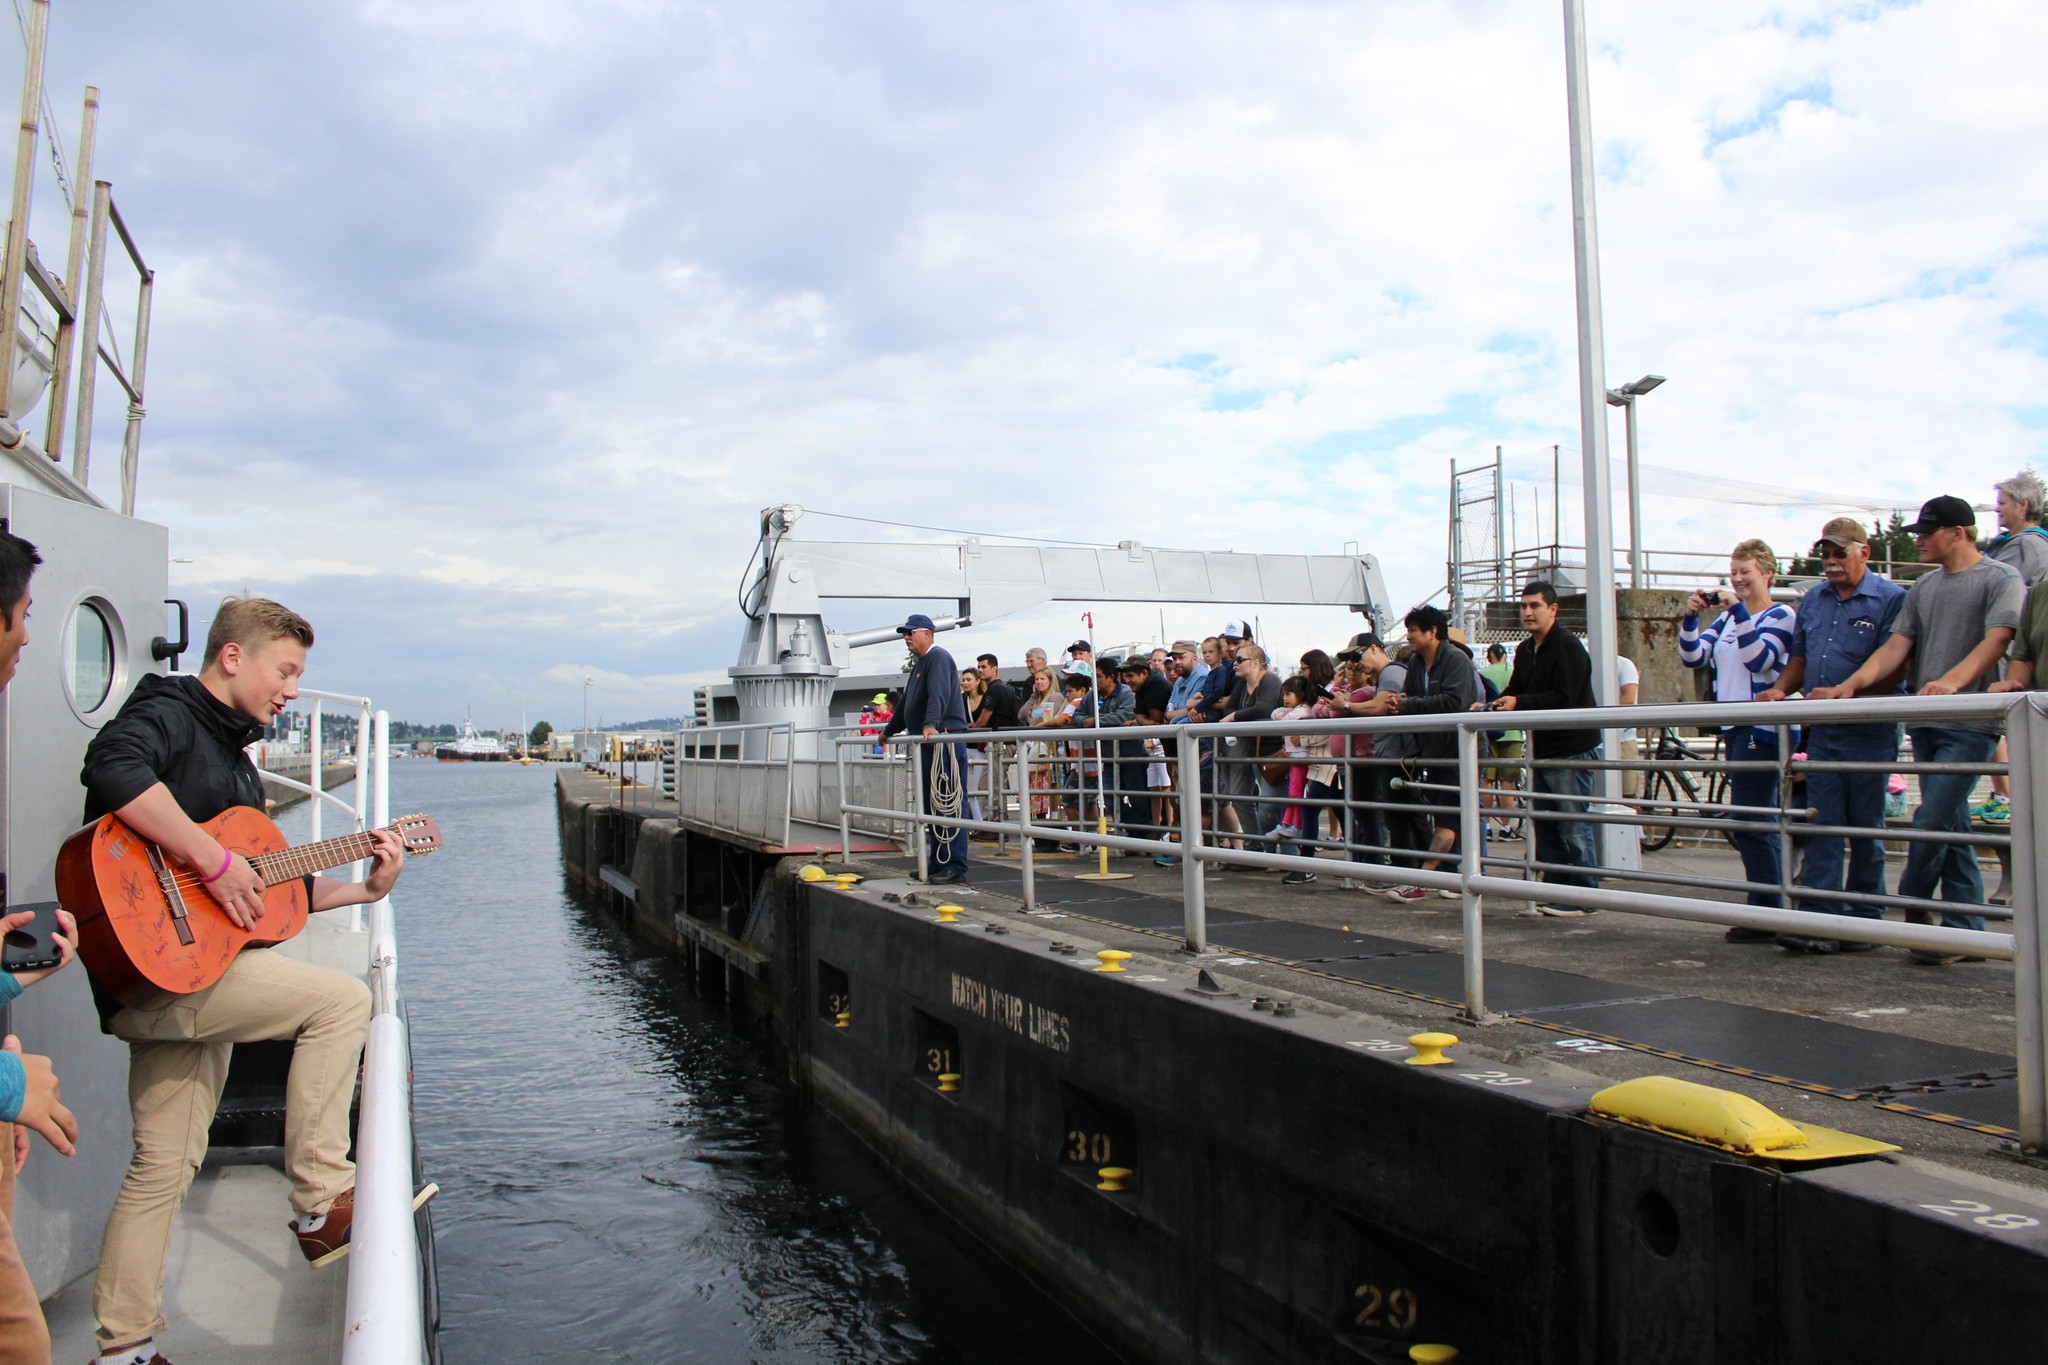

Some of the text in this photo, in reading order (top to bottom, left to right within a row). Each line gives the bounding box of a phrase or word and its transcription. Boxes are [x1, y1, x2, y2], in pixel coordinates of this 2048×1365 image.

[951, 971, 1070, 1053] WATCH YOUR LINES
[1345, 1038, 1409, 1052] 29
[926, 1048, 951, 1073] 31
[1458, 1070, 1533, 1086] 29
[1067, 1130, 1111, 1164] 30
[1917, 1199, 2041, 1229] 28
[1354, 1283, 1417, 1331] 29
